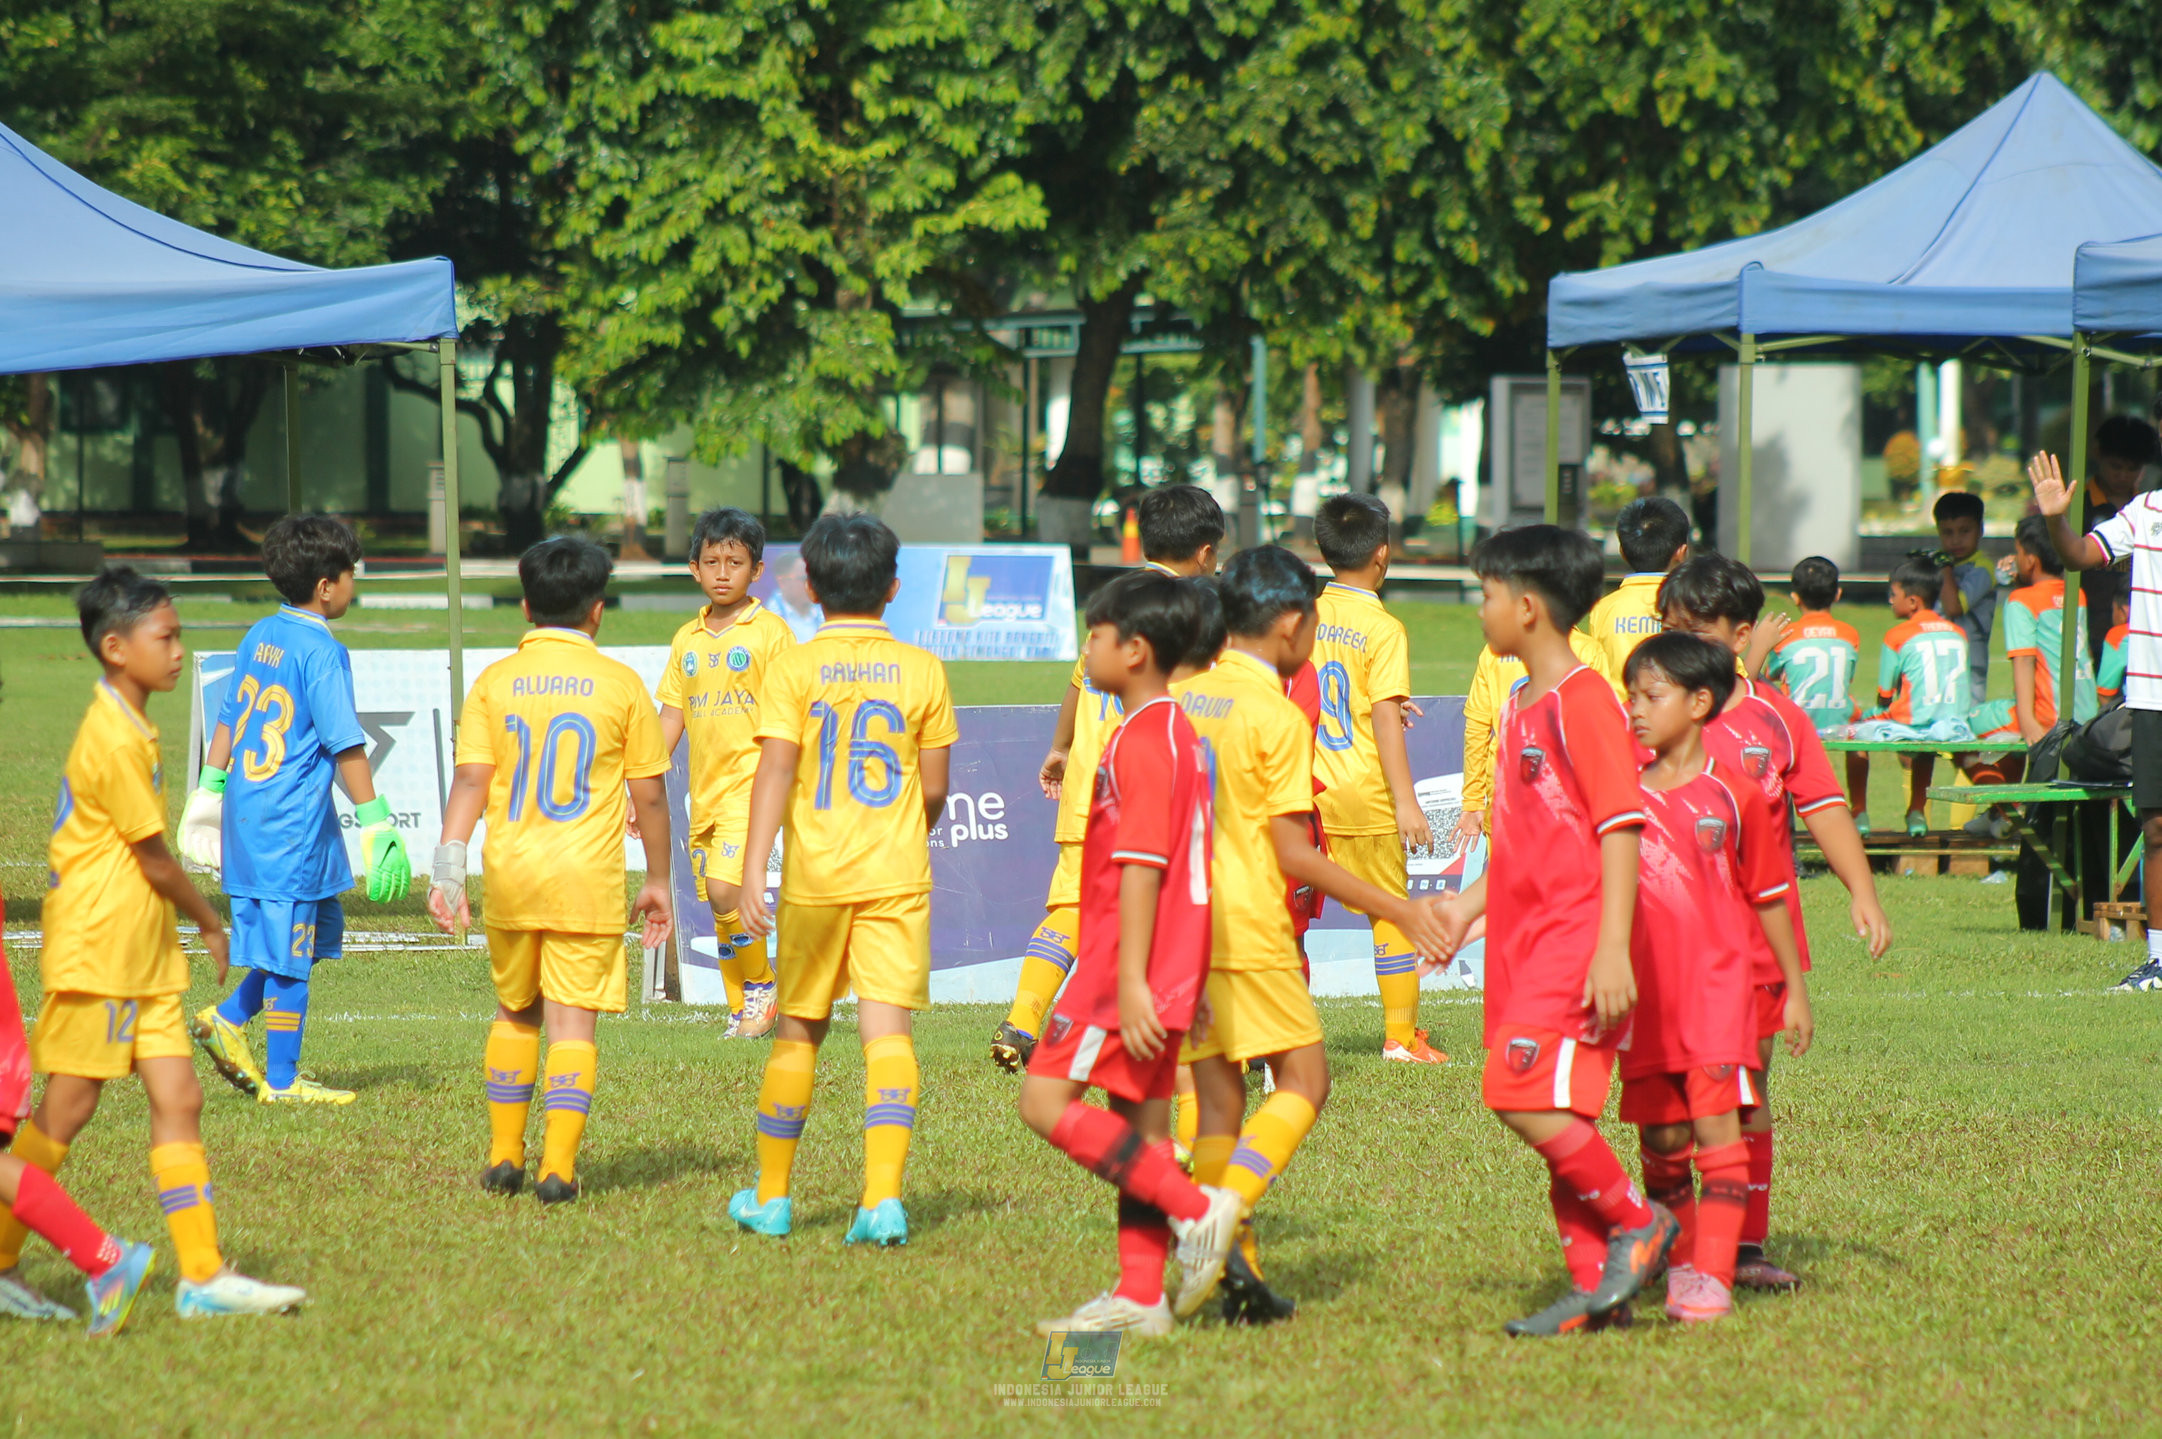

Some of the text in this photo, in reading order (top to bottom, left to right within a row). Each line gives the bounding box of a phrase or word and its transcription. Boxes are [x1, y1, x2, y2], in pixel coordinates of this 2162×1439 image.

[968, 596, 1042, 622] League
[1615, 616, 1662, 633] KEM
[513, 675, 594, 696] ALVARO
[1793, 646, 1847, 709] 21
[1915, 639, 1967, 705] 17
[714, 689, 754, 706] JAYA
[1317, 661, 1353, 751] 9
[226, 674, 294, 782] 23
[505, 712, 596, 822] 10
[810, 699, 905, 808] 16
[951, 823, 1009, 848] plus
[292, 923, 315, 958] 23
[105, 1000, 137, 1043] 12
